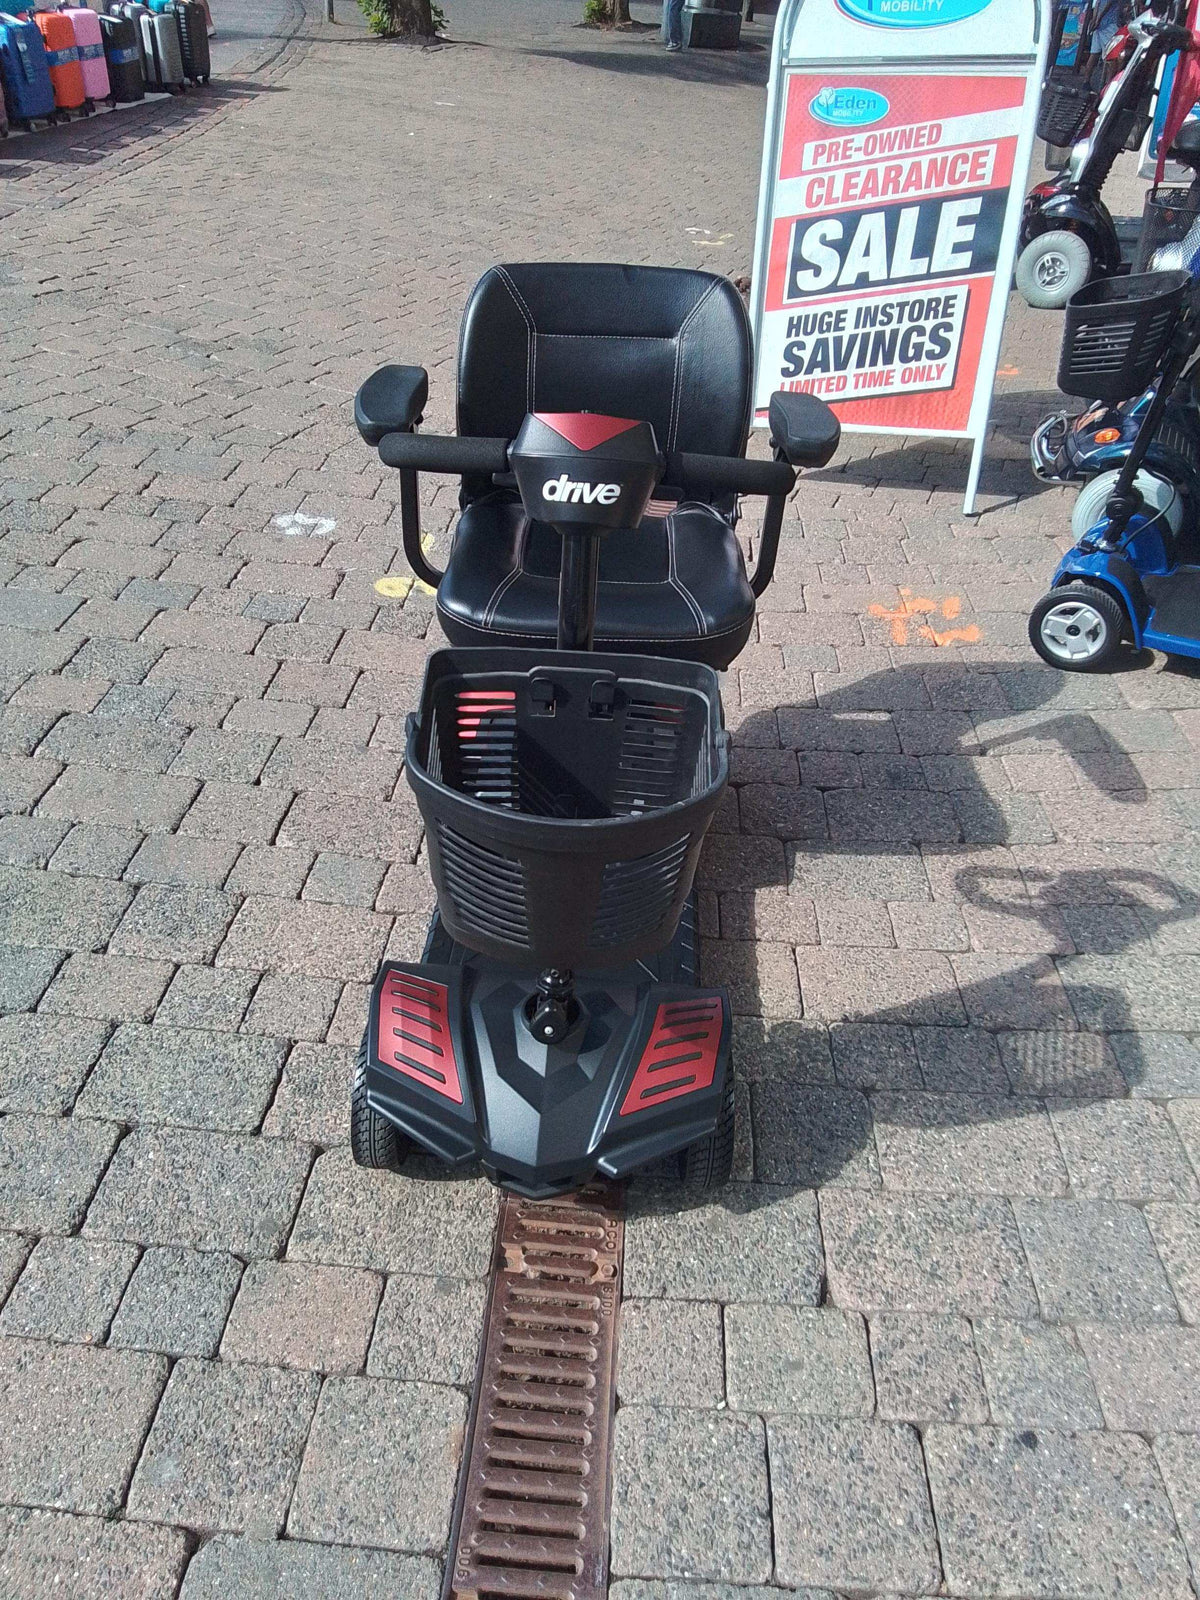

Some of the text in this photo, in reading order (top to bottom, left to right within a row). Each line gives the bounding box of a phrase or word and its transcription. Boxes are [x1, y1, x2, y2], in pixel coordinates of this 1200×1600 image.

[880, 0, 943, 12] MOBILITY
[834, 94, 877, 109] Eden
[812, 123, 942, 165] PRE-OWNED
[805, 149, 990, 209] CLEARANCE
[796, 196, 983, 292] SALE
[786, 295, 957, 338] HUGE INSTORE
[780, 322, 954, 378] SAVINGS
[853, 369, 896, 390] TIME
[900, 363, 948, 385] ONLY
[541, 473, 621, 505] drive
